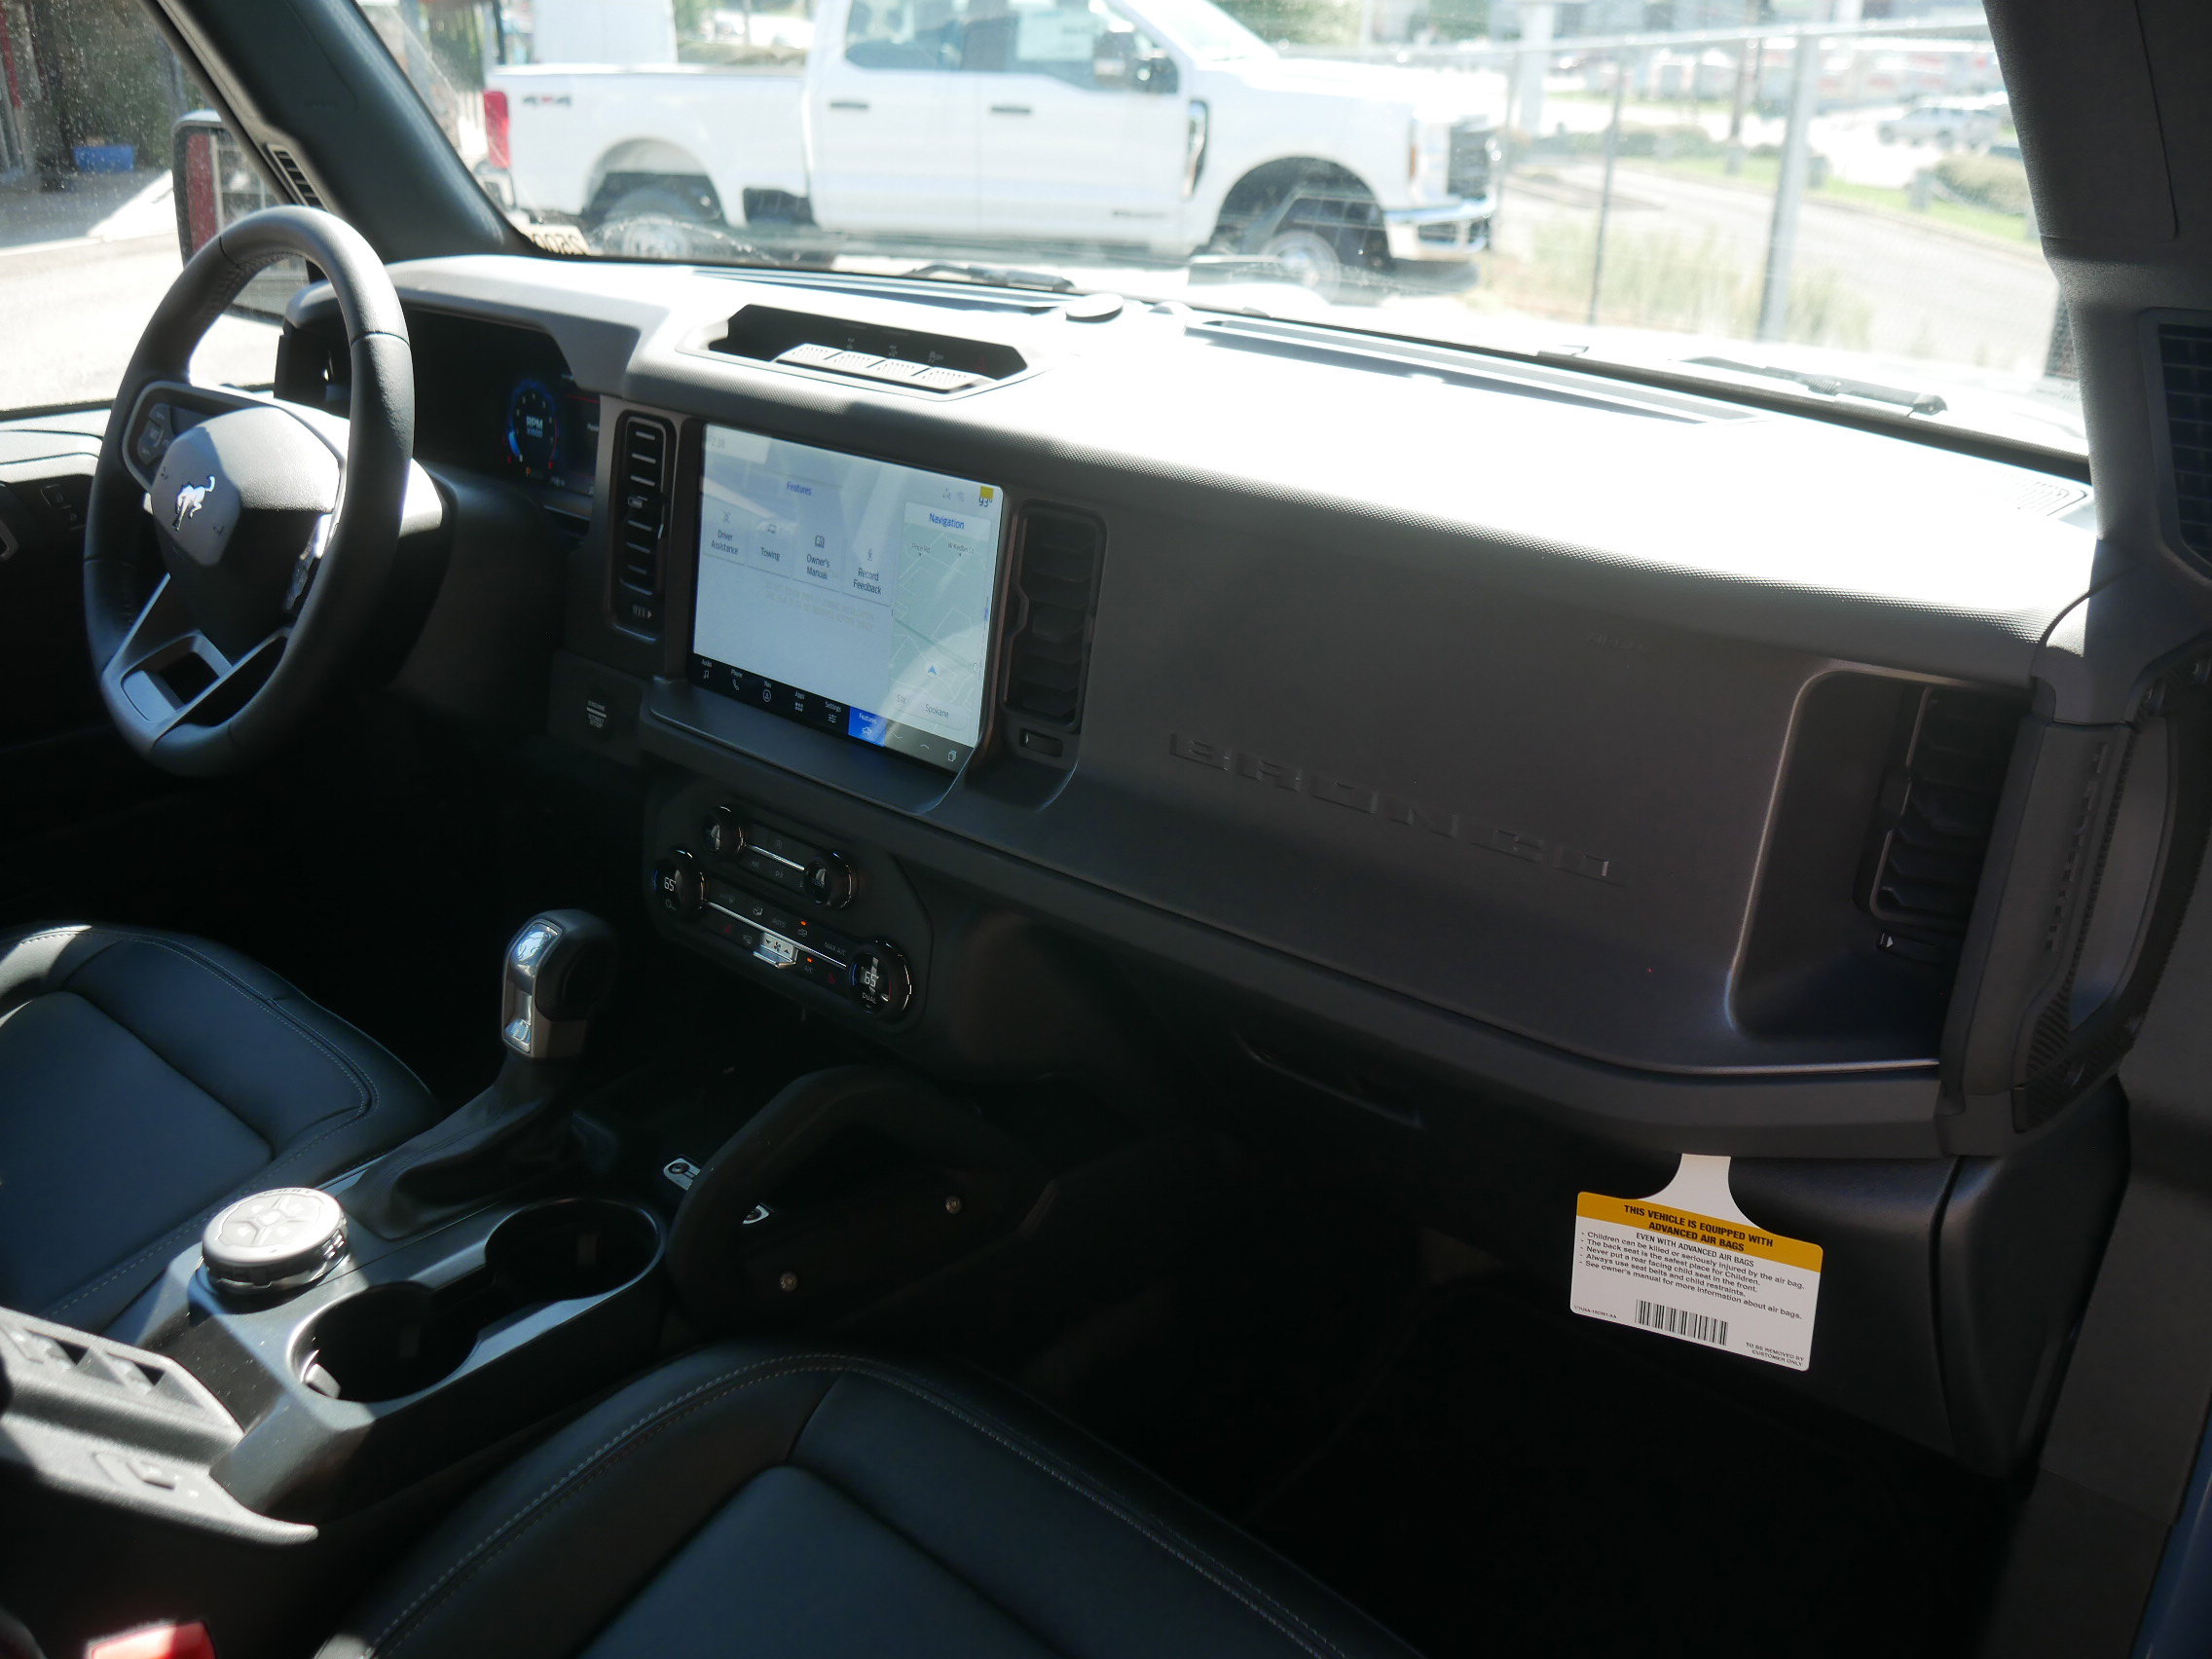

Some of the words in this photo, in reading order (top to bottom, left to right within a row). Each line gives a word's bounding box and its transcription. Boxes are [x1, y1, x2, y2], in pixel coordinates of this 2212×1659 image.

[787, 481, 812, 496] Features
[929, 513, 965, 530] Navigation
[718, 530, 733, 541] Driver
[711, 540, 739, 555] Assistance
[761, 547, 781, 562] Towing
[806, 554, 830, 568] Owner's
[807, 567, 828, 579] Manual
[858, 568, 879, 581] Record
[854, 579, 882, 595] Feedback
[826, 701, 841, 713] Settings
[925, 704, 949, 718] Spokane
[1169, 731, 1628, 889] BRONCO
[1624, 1205, 1644, 1216] THIS
[1648, 1209, 1685, 1225] VEHICLE
[1688, 1220, 1696, 1229] IS
[1700, 1223, 1746, 1240] EQUIPPED
[1749, 1235, 1773, 1247] WITH
[1649, 1222, 1698, 1239] ADVANCED
[1701, 1235, 1716, 1244] AIR
[1719, 1239, 1745, 1251] BAGS
[1637, 1233, 1655, 1242] EVEN
[1658, 1237, 1677, 1247] WITH
[1678, 1243, 1716, 1258] ADVANCED
[1719, 1253, 1732, 1262] AIR
[1734, 1257, 1754, 1267] BAGS
[1587, 1238, 1601, 1247] The
[1603, 1241, 1621, 1251] back
[1624, 1247, 1640, 1256] seat
[1650, 1251, 1662, 1260] the
[1664, 1256, 1687, 1267] safest
[1689, 1262, 1710, 1272] place
[1725, 1270, 1760, 1285] Children.
[1588, 1232, 1620, 1243] Children
[1638, 1240, 1647, 1249] be
[1649, 1244, 1670, 1254] killed
[1681, 1252, 1716, 1268] seriously
[1719, 1262, 1747, 1273] injured
[1749, 1268, 1758, 1277] by
[1760, 1272, 1772, 1280] the
[1788, 1279, 1805, 1289] bag.
[1586, 1246, 1608, 1256] Never
[1610, 1251, 1623, 1260] put
[1649, 1260, 1672, 1271] facing
[1675, 1265, 1692, 1275] child
[1695, 1272, 1711, 1280] seat
[1722, 1277, 1735, 1286] the
[1737, 1281, 1757, 1292] front.
[1586, 1253, 1613, 1264] Always
[1649, 1267, 1667, 1276] belts
[1670, 1272, 1684, 1280] and
[1685, 1275, 1704, 1285] child
[1707, 1281, 1746, 1297] restraints.
[1586, 1260, 1600, 1269] See
[1602, 1265, 1631, 1275] owner's
[1633, 1272, 1661, 1282] manual
[1663, 1277, 1674, 1286] for
[1676, 1281, 1695, 1291] more
[1698, 1287, 1741, 1304] information
[1744, 1300, 1766, 1309] about
[1780, 1309, 1802, 1319] bags.
[1752, 1349, 1786, 1362] CUSTOMER
[1765, 1347, 1794, 1359] REMOVED
